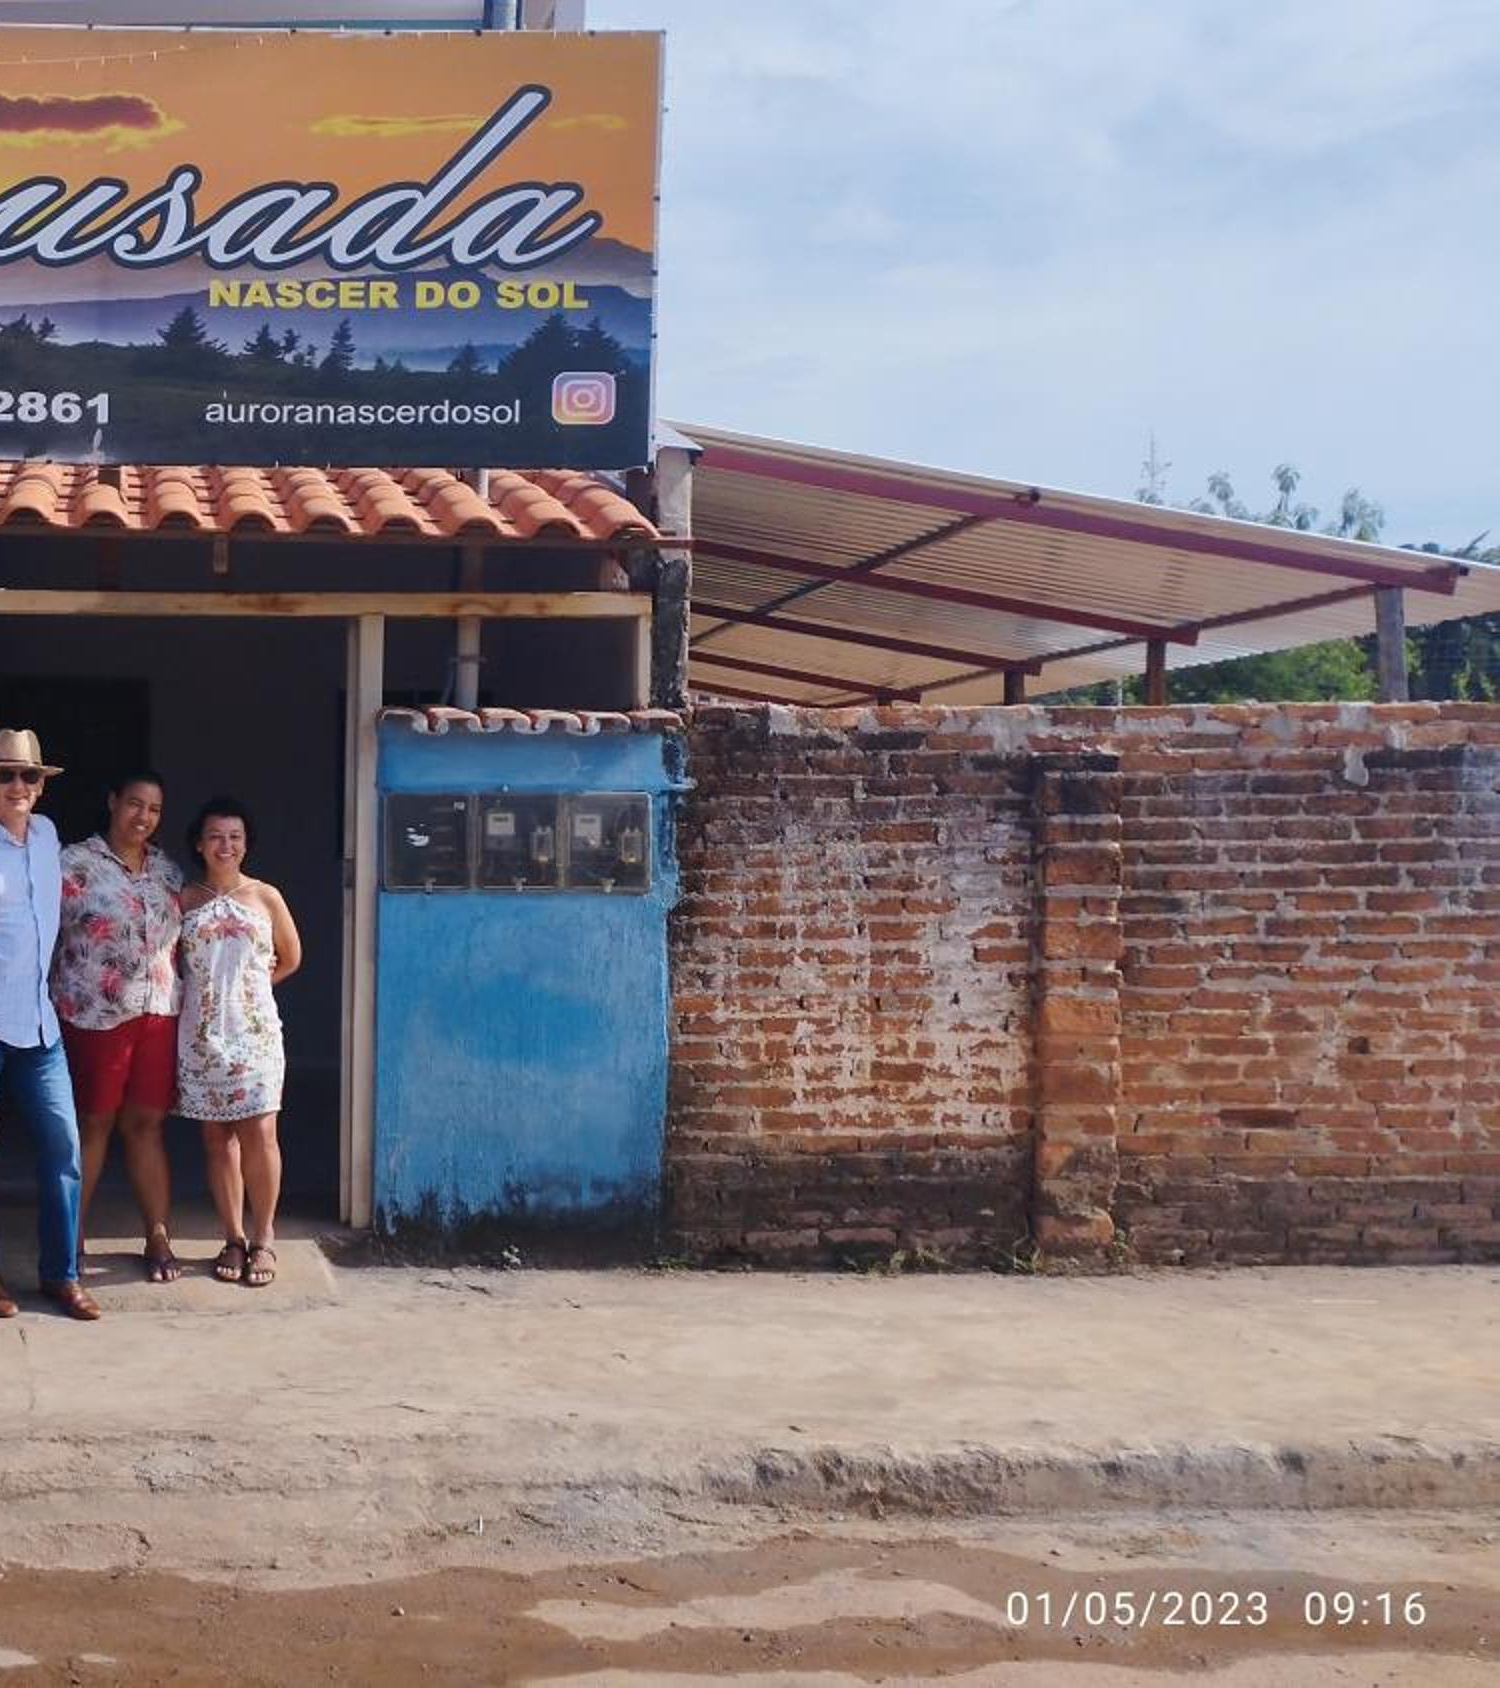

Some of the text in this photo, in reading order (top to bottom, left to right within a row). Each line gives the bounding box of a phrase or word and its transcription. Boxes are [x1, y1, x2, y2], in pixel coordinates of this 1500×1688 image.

[208, 280, 589, 309] NASCER DO SOL
[205, 399, 521, 425] auroranascerdosol
